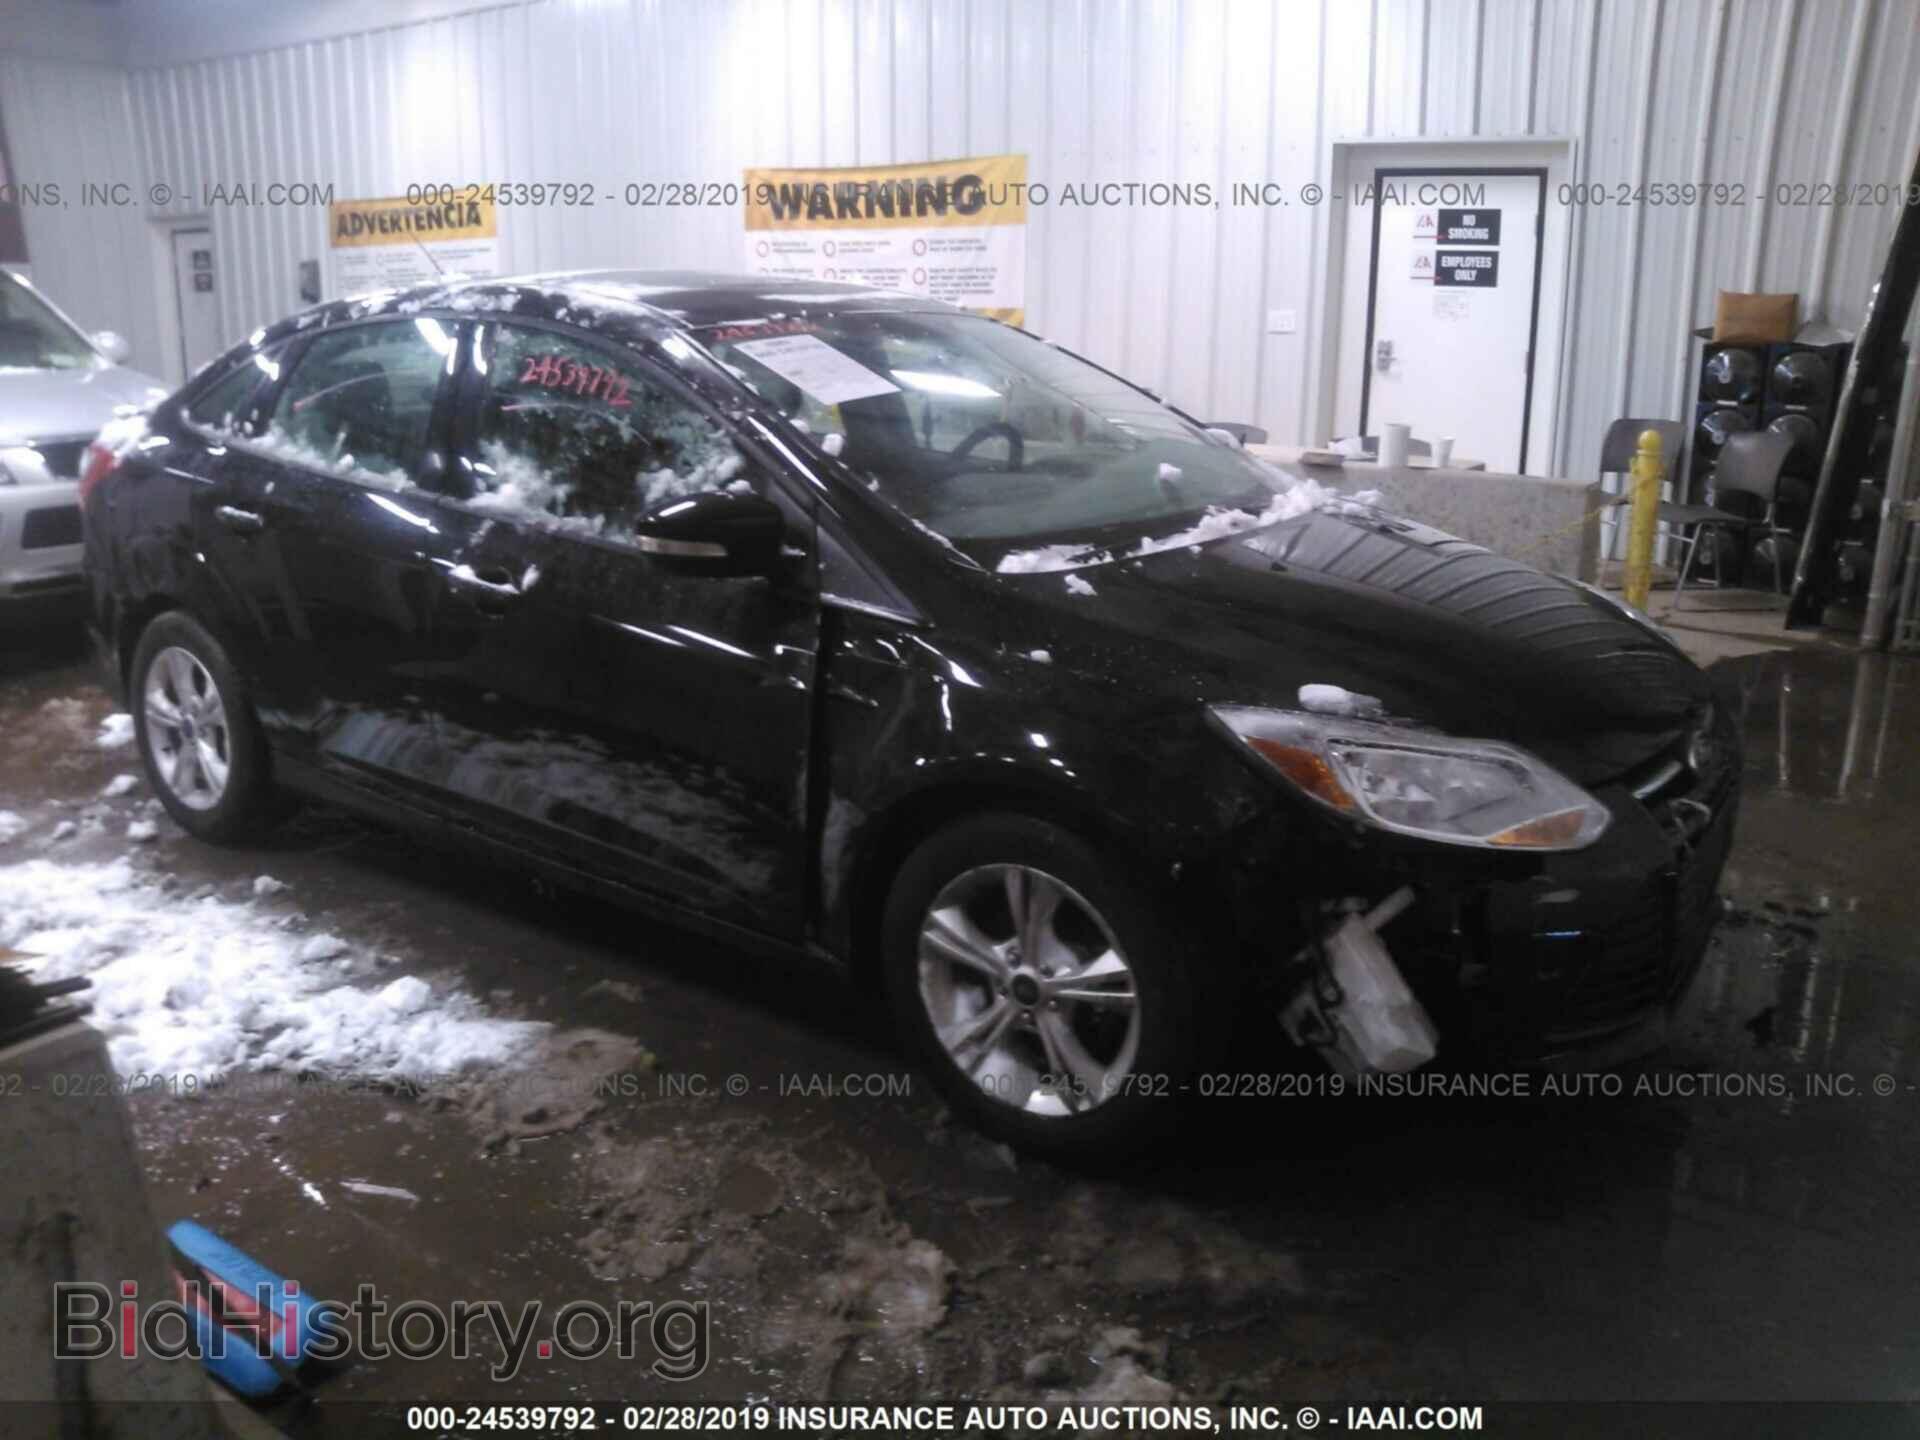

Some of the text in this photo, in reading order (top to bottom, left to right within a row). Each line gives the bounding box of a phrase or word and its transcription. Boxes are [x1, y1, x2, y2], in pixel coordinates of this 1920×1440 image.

[767, 173, 987, 220] WARNING
[335, 202, 483, 239] ADVERTENCIA
[1462, 213, 1476, 226] NO
[1447, 227, 1489, 240] SMOKING
[1441, 255, 1492, 268] EMPLOYEES
[1454, 269, 1477, 281] ONLY
